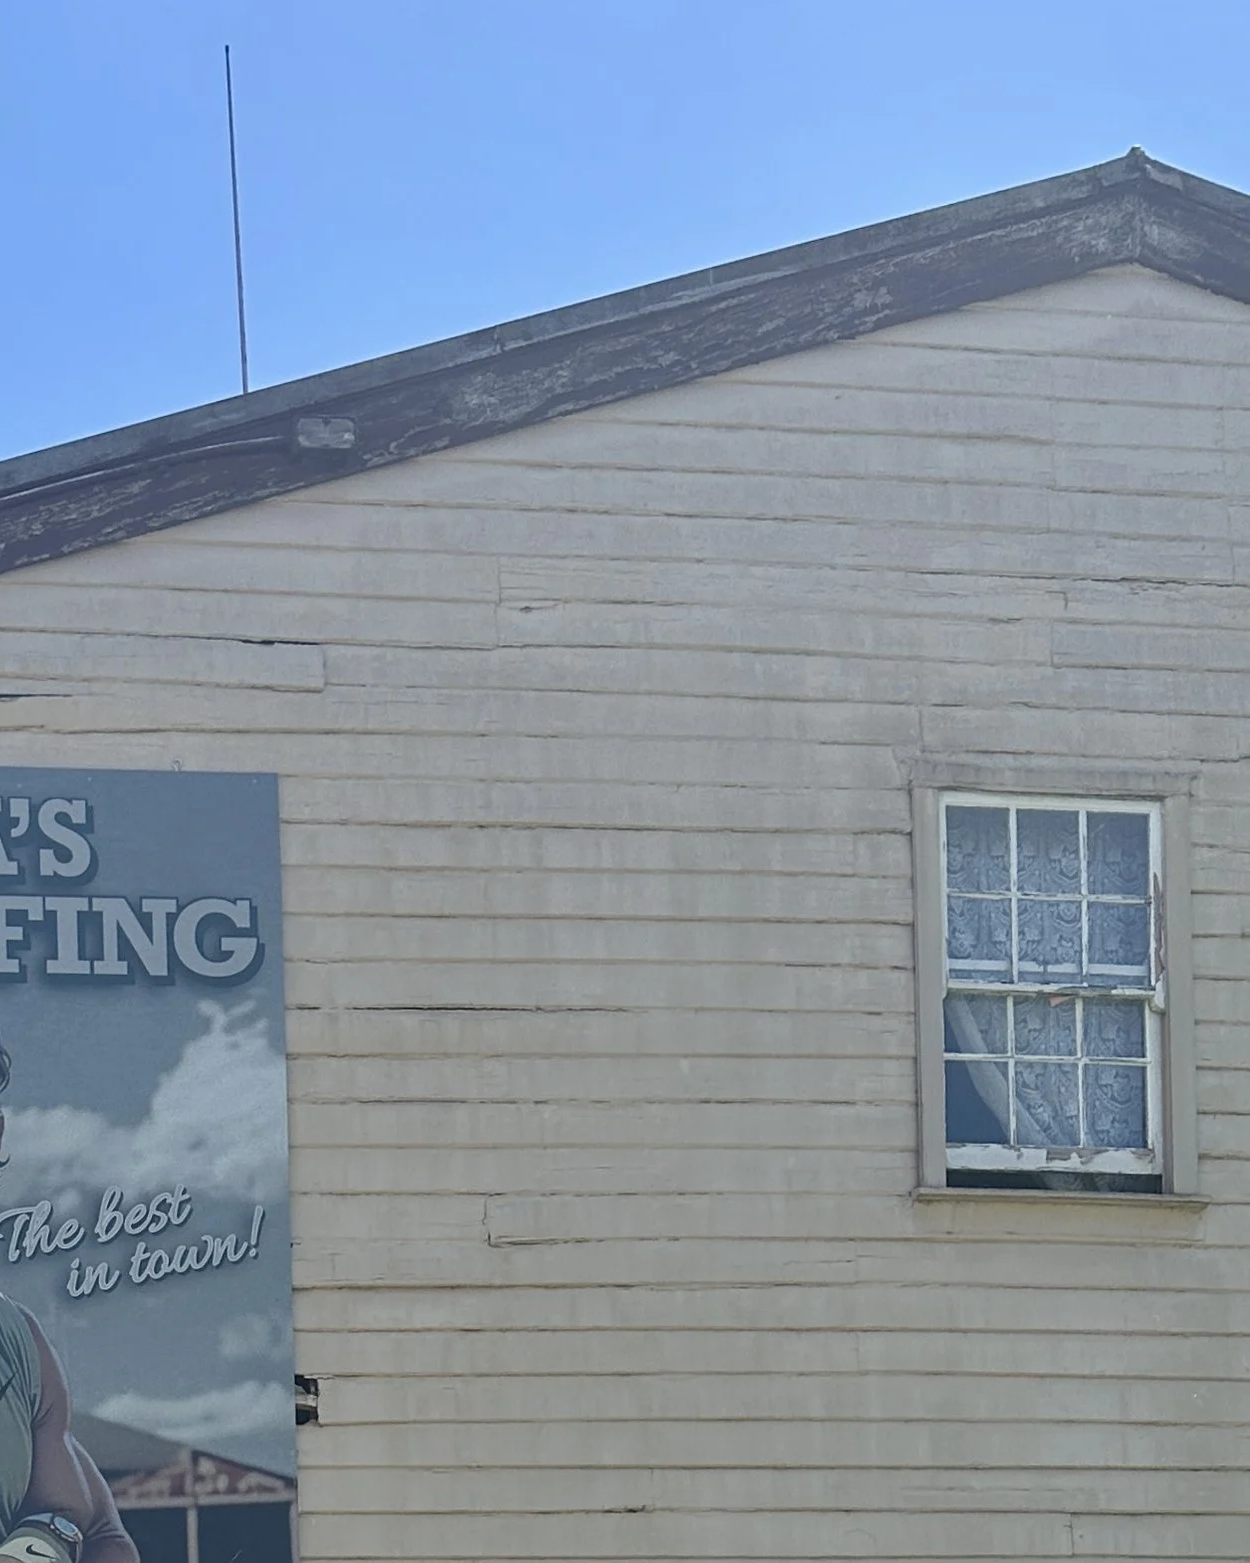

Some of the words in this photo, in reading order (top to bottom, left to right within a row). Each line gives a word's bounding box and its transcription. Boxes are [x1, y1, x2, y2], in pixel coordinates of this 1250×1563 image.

[67, 1258, 120, 1297] in
[129, 1205, 264, 1284] town!
[95, 1184, 192, 1243] best
